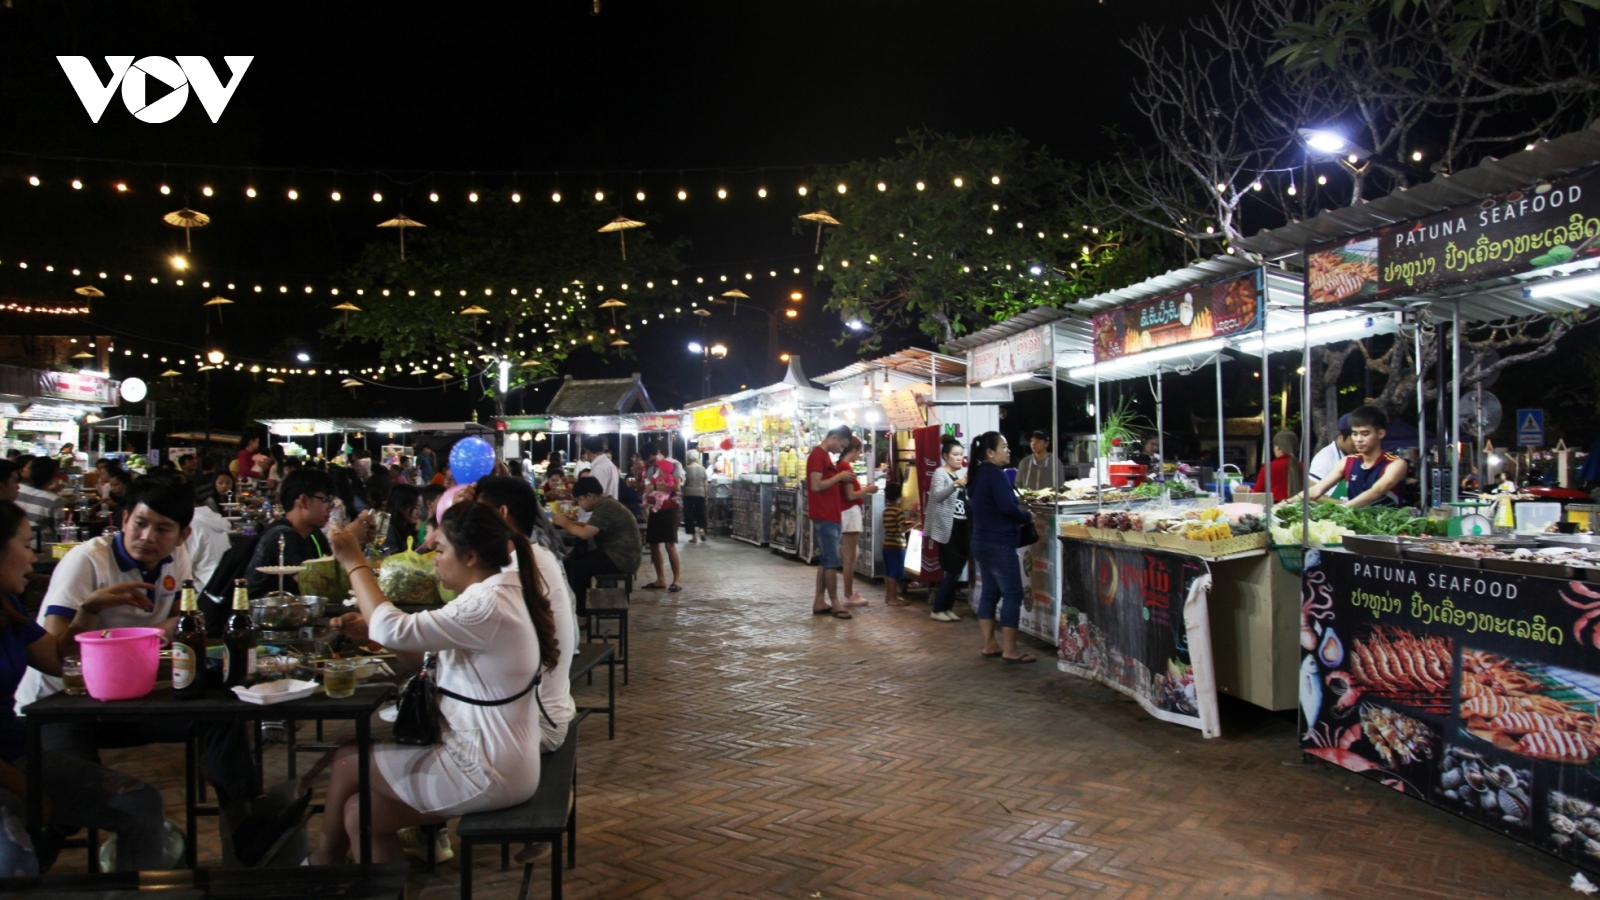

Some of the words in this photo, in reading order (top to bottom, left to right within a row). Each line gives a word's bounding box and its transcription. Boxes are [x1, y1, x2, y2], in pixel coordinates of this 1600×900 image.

[1396, 217, 1468, 249] PATUNA
[1479, 185, 1582, 228] SEAFOOD
[1353, 562, 1418, 585] PATUNA
[1428, 573, 1519, 600] SEAFOOD
